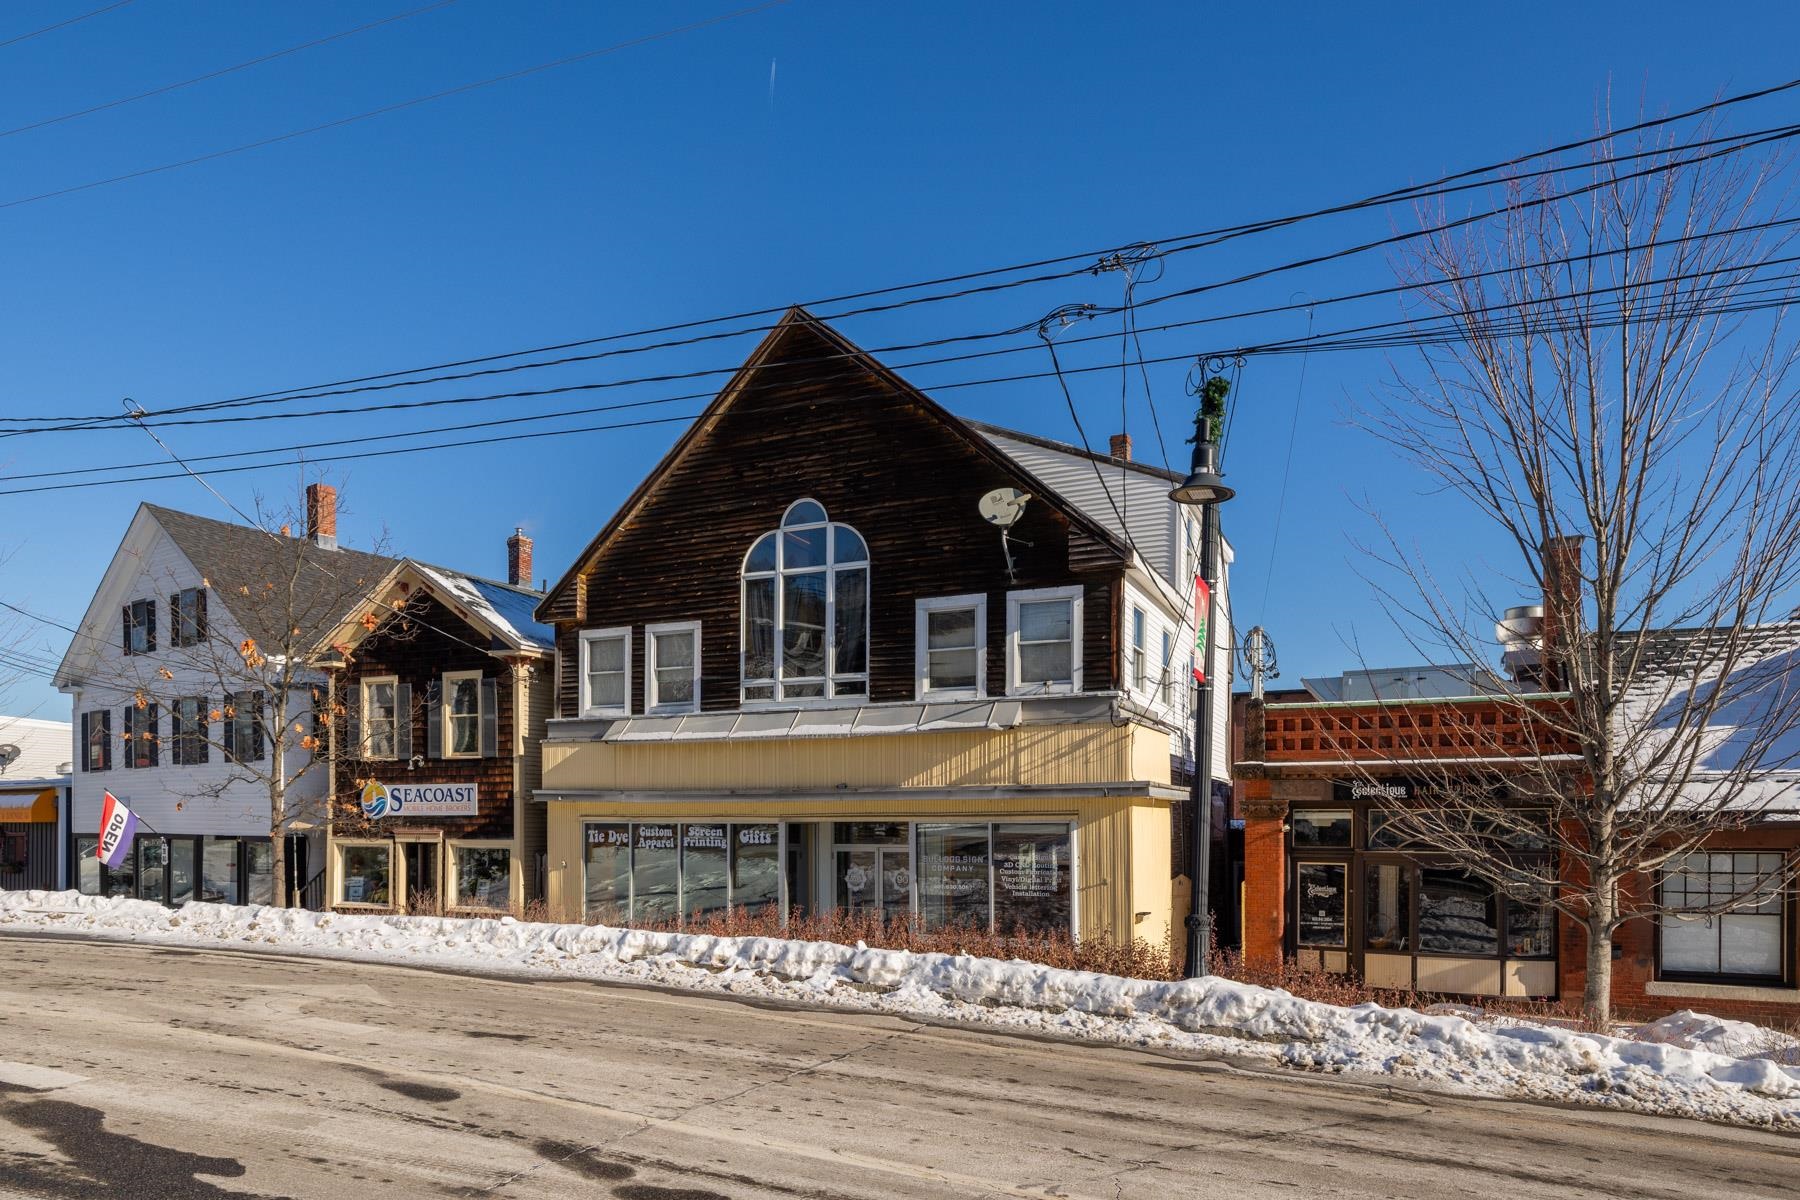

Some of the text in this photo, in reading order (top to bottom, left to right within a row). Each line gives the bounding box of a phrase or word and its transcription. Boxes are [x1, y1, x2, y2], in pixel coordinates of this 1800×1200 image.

[390, 787, 474, 811] SEACOAST
[639, 826, 672, 837] Custom
[688, 826, 723, 837] Screen
[739, 829, 772, 844] Gifts
[588, 830, 629, 845] Tie Dye
[638, 837, 674, 848] Apparel
[683, 836, 727, 848] Printing
[962, 855, 984, 864] SIGN
